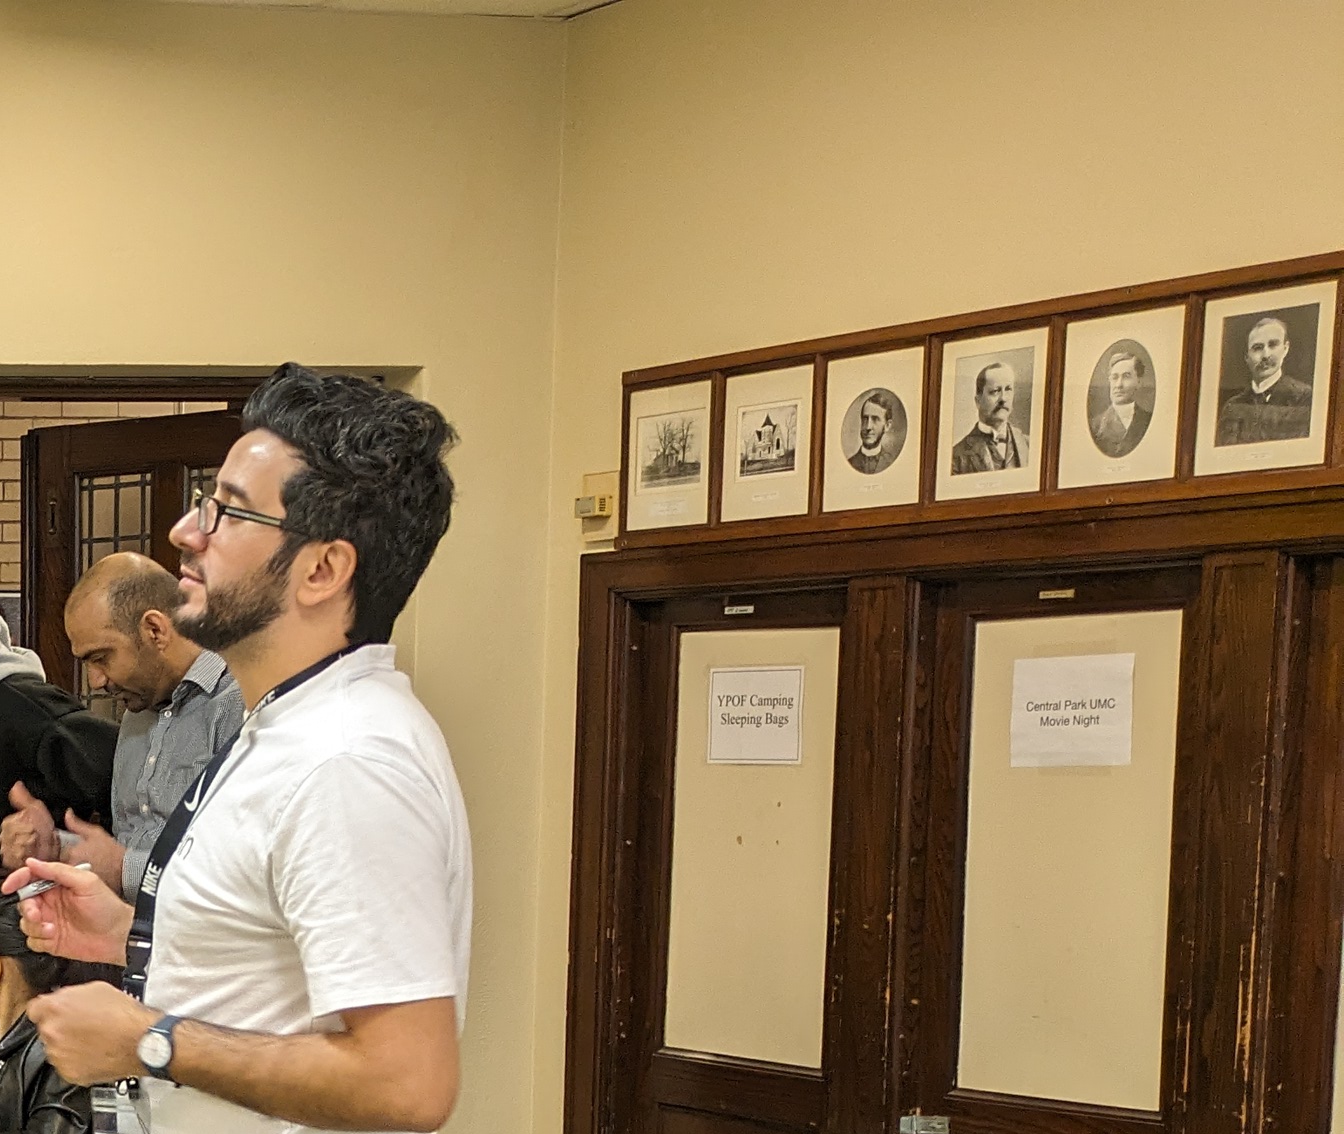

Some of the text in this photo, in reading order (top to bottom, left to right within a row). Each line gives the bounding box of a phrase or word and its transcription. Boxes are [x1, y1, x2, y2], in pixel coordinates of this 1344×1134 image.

[718, 694, 793, 709] YPOF Camping
[1026, 698, 1115, 712] Central Park UMC
[721, 712, 789, 728] Sleeping Bags
[1040, 715, 1100, 727] Movie Night
[141, 861, 162, 896] NIKE
